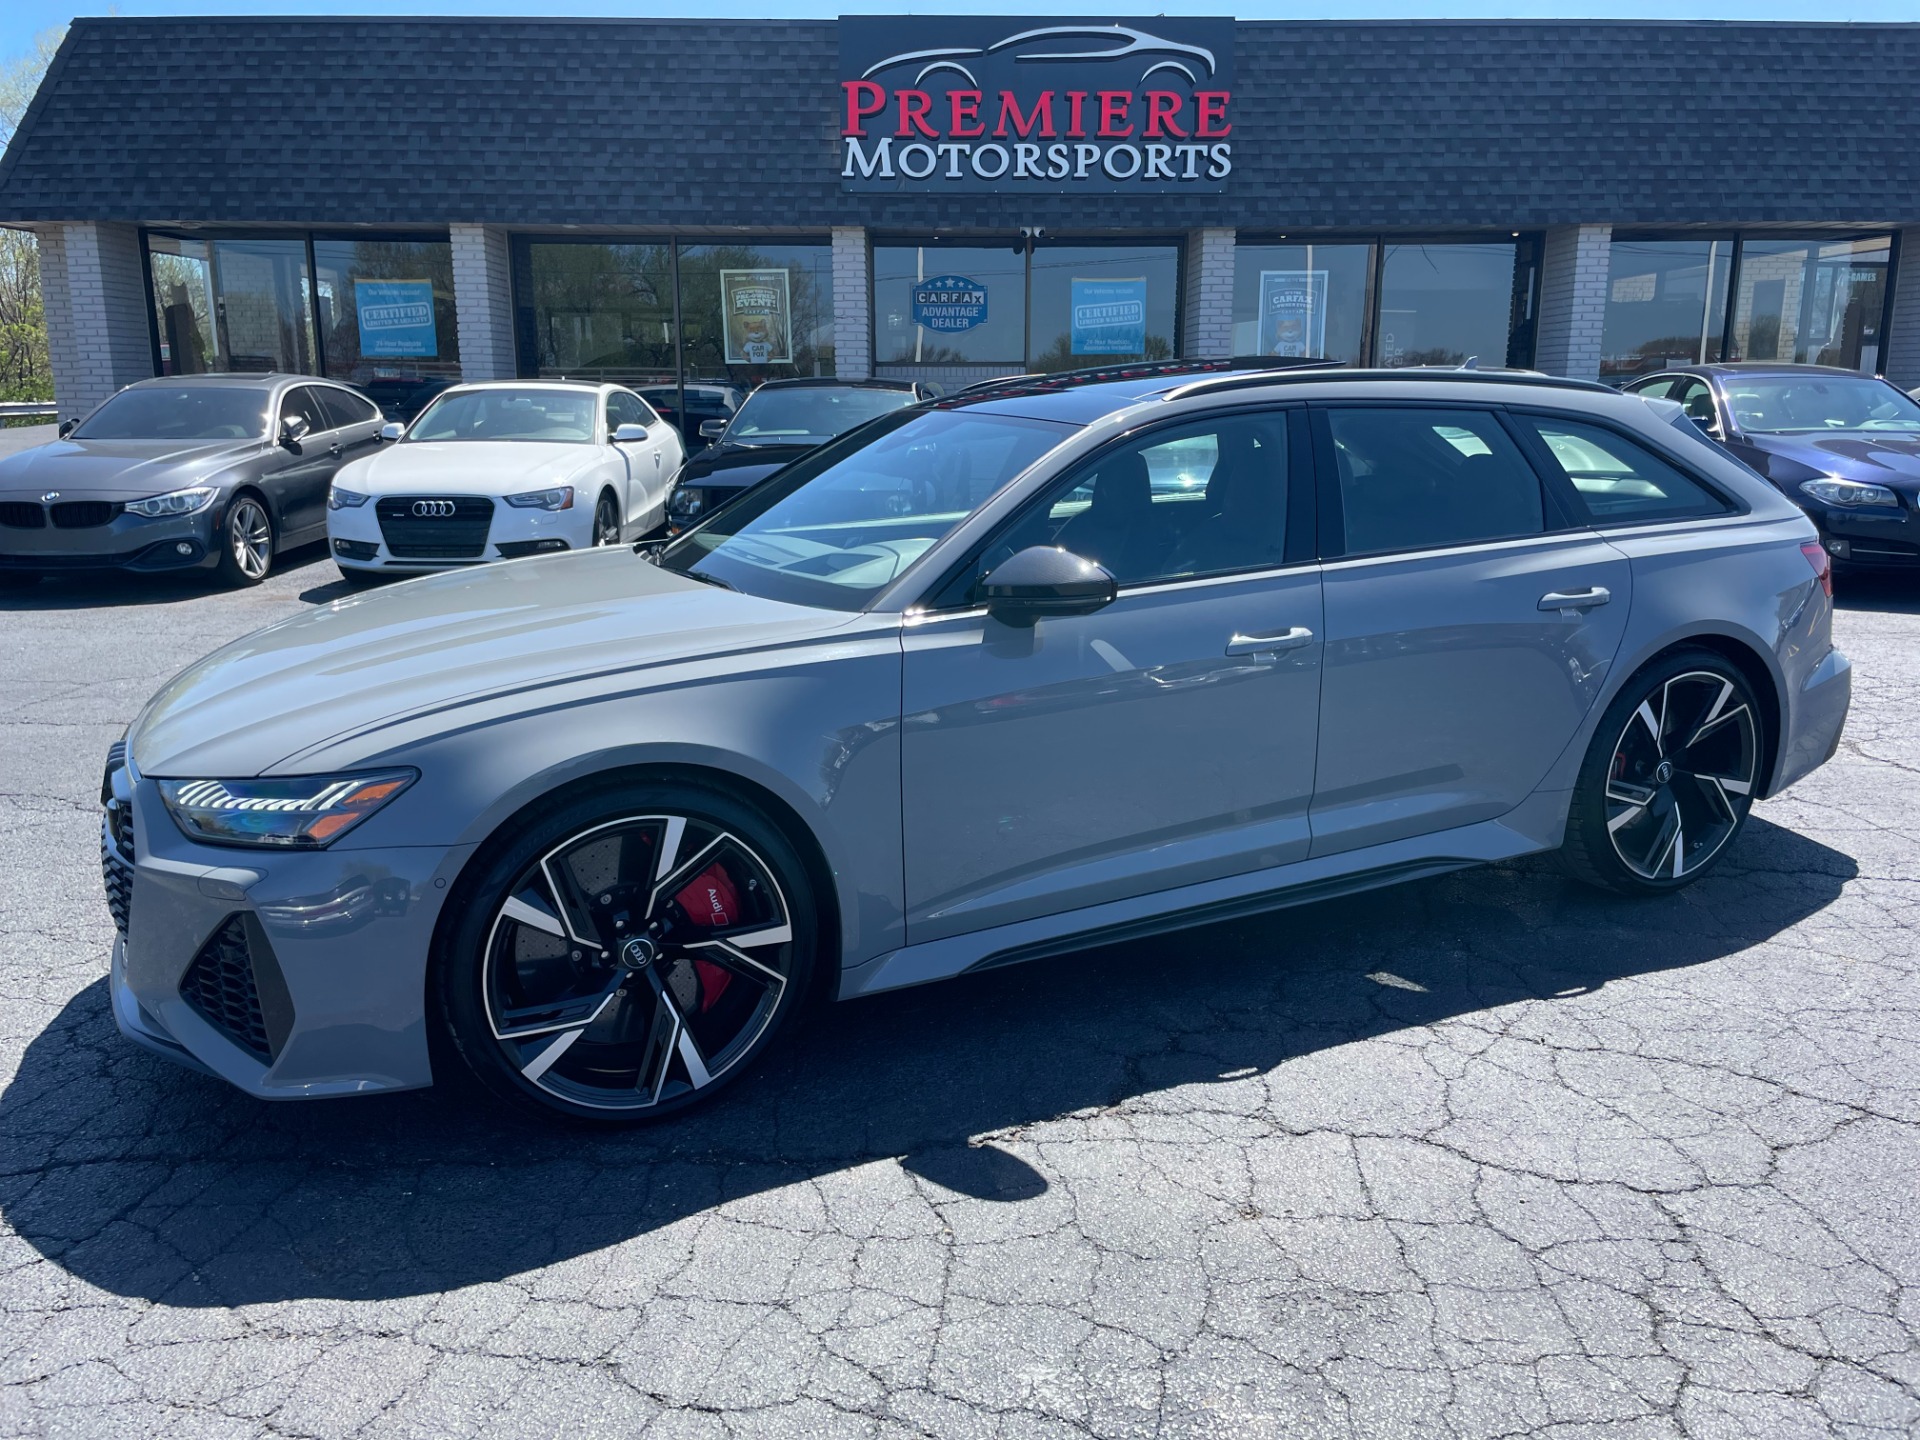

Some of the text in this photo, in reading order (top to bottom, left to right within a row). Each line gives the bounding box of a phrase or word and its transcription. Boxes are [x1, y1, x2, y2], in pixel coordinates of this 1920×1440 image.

[841, 81, 1232, 138] PREMIERE
[841, 137, 1232, 178] MOTORSPORTS
[736, 298, 776, 308] EVENT!
[917, 292, 983, 304] CARFAX
[365, 305, 427, 320] CERTIFIED
[922, 306, 979, 317] ADVANTAGE
[1078, 304, 1139, 319] CERTIFIED
[931, 318, 969, 328] DEALER
[707, 888, 723, 913] Audi
